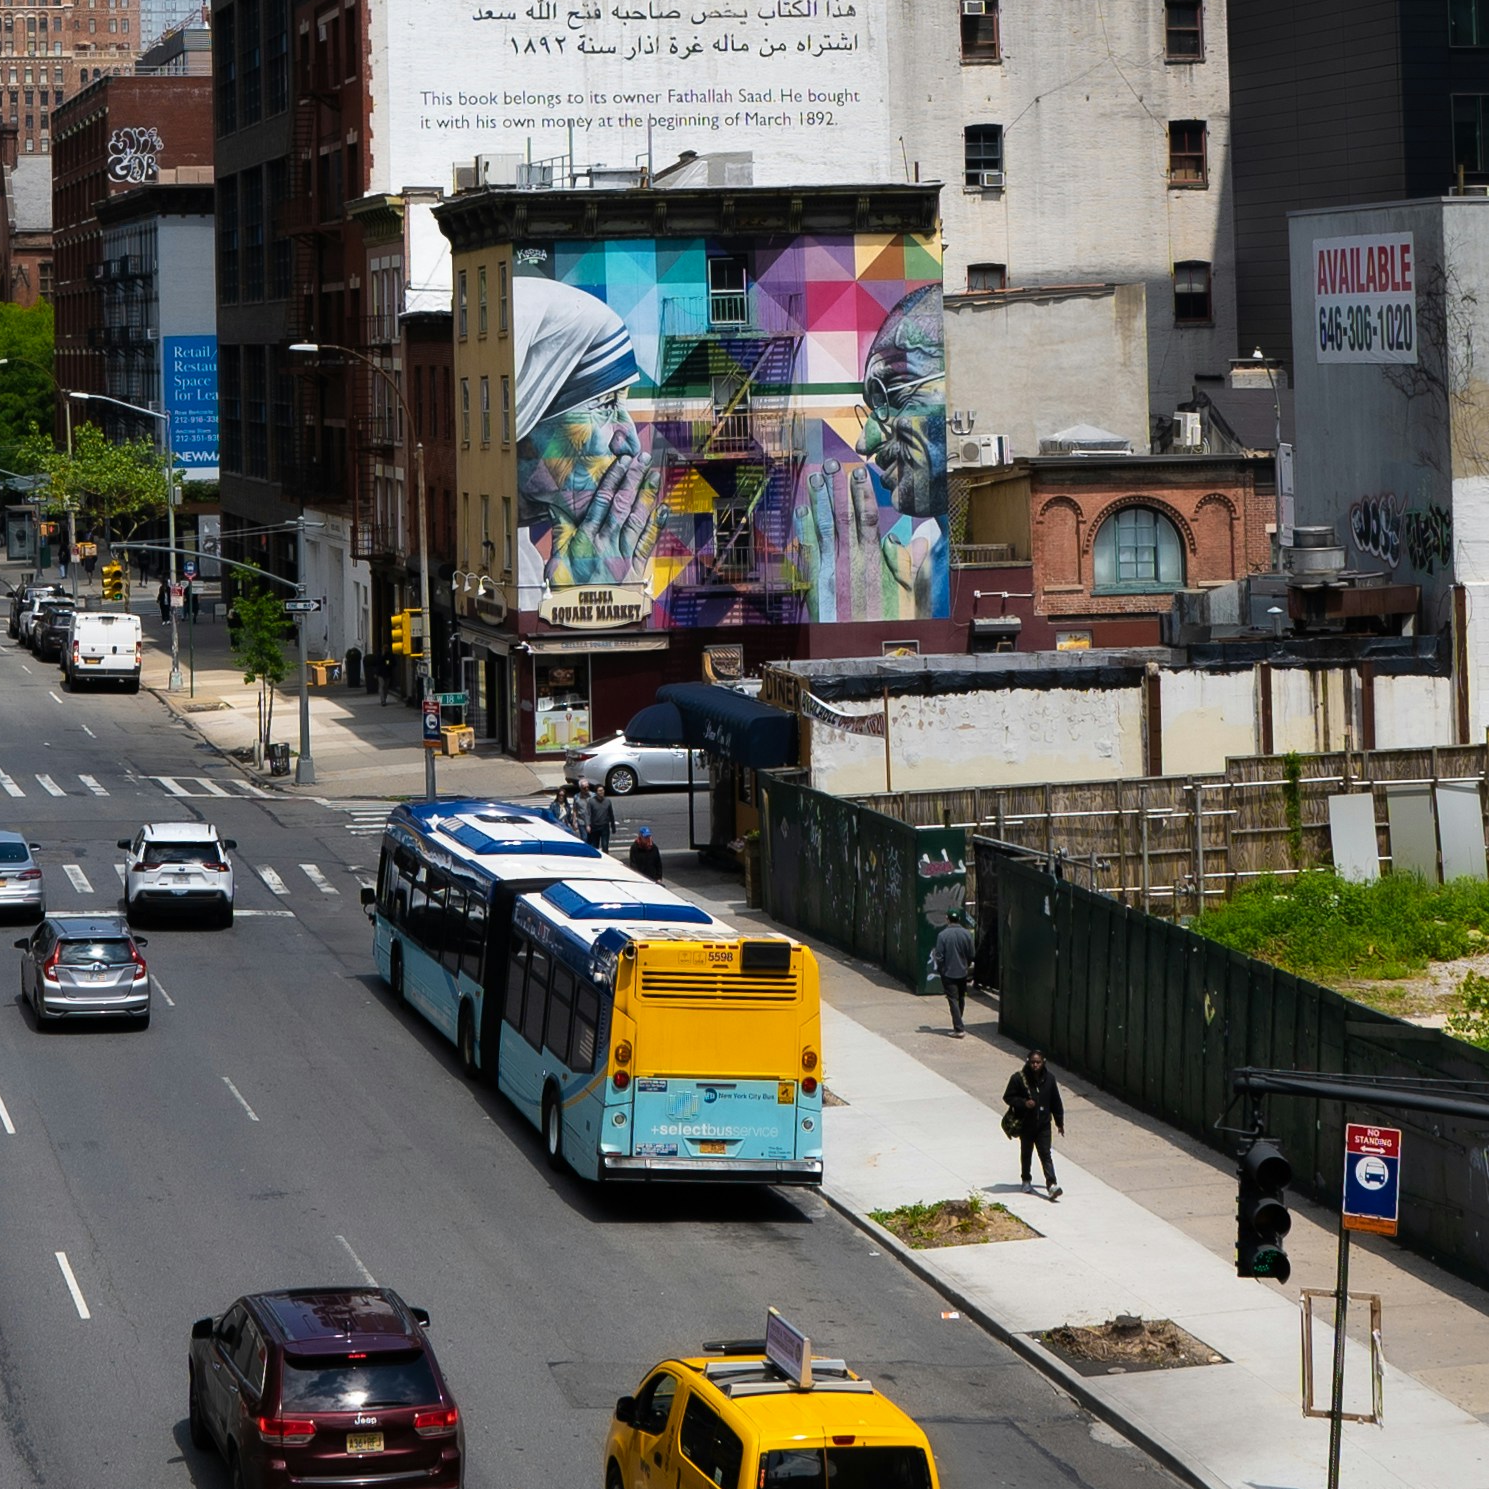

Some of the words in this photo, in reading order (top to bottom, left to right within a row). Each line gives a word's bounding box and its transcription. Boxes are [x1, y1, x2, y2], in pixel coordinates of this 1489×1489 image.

[472, 7, 517, 22] سعد
[567, 1, 602, 30] فتح
[611, 1, 681, 27] صاحبه
[757, 0, 818, 27] الكتاب
[511, 35, 567, 56] ١٨٩٢
[576, 34, 618, 55] سنة
[669, 35, 704, 60] غرة
[758, 38, 787, 58] من
[796, 32, 859, 57] اشتراه
[419, 90, 453, 106] This
[458, 91, 499, 106] book
[503, 90, 562, 109] belongs
[566, 93, 585, 105] to
[589, 90, 608, 105] its
[612, 93, 662, 105] owner
[667, 88, 733, 104] Fathallah
[738, 88, 776, 104] Saad.
[780, 88, 803, 104] He
[807, 87, 861, 107] bought
[420, 115, 432, 130] it
[436, 114, 470, 130] with
[476, 113, 497, 129] his
[502, 118, 536, 129] own
[541, 115, 593, 133] money
[598, 116, 614, 129] at
[617, 113, 643, 129] the
[648, 112, 719, 133] beginning
[724, 111, 741, 127] of
[745, 111, 792, 127] March
[799, 110, 838, 127] 1892.
[1317, 244, 1412, 295] AVAILABLE
[1319, 303, 1412, 352] 646-306-1020
[173, 375, 212, 390] Space
[174, 389, 194, 401] for
[578, 590, 614, 606] CHELSEA
[551, 605, 593, 623] SQUARE
[595, 604, 642, 622] MARKET
[764, 670, 801, 711] DINER
[708, 951, 733, 962] 5598
[733, 1092, 747, 1100] York
[748, 1093, 762, 1101] City
[762, 1093, 775, 1101] Bus
[1354, 1135, 1392, 1147] STANDING
[1367, 1128, 1380, 1137] NO
[354, 1412, 377, 1426] Jeep
